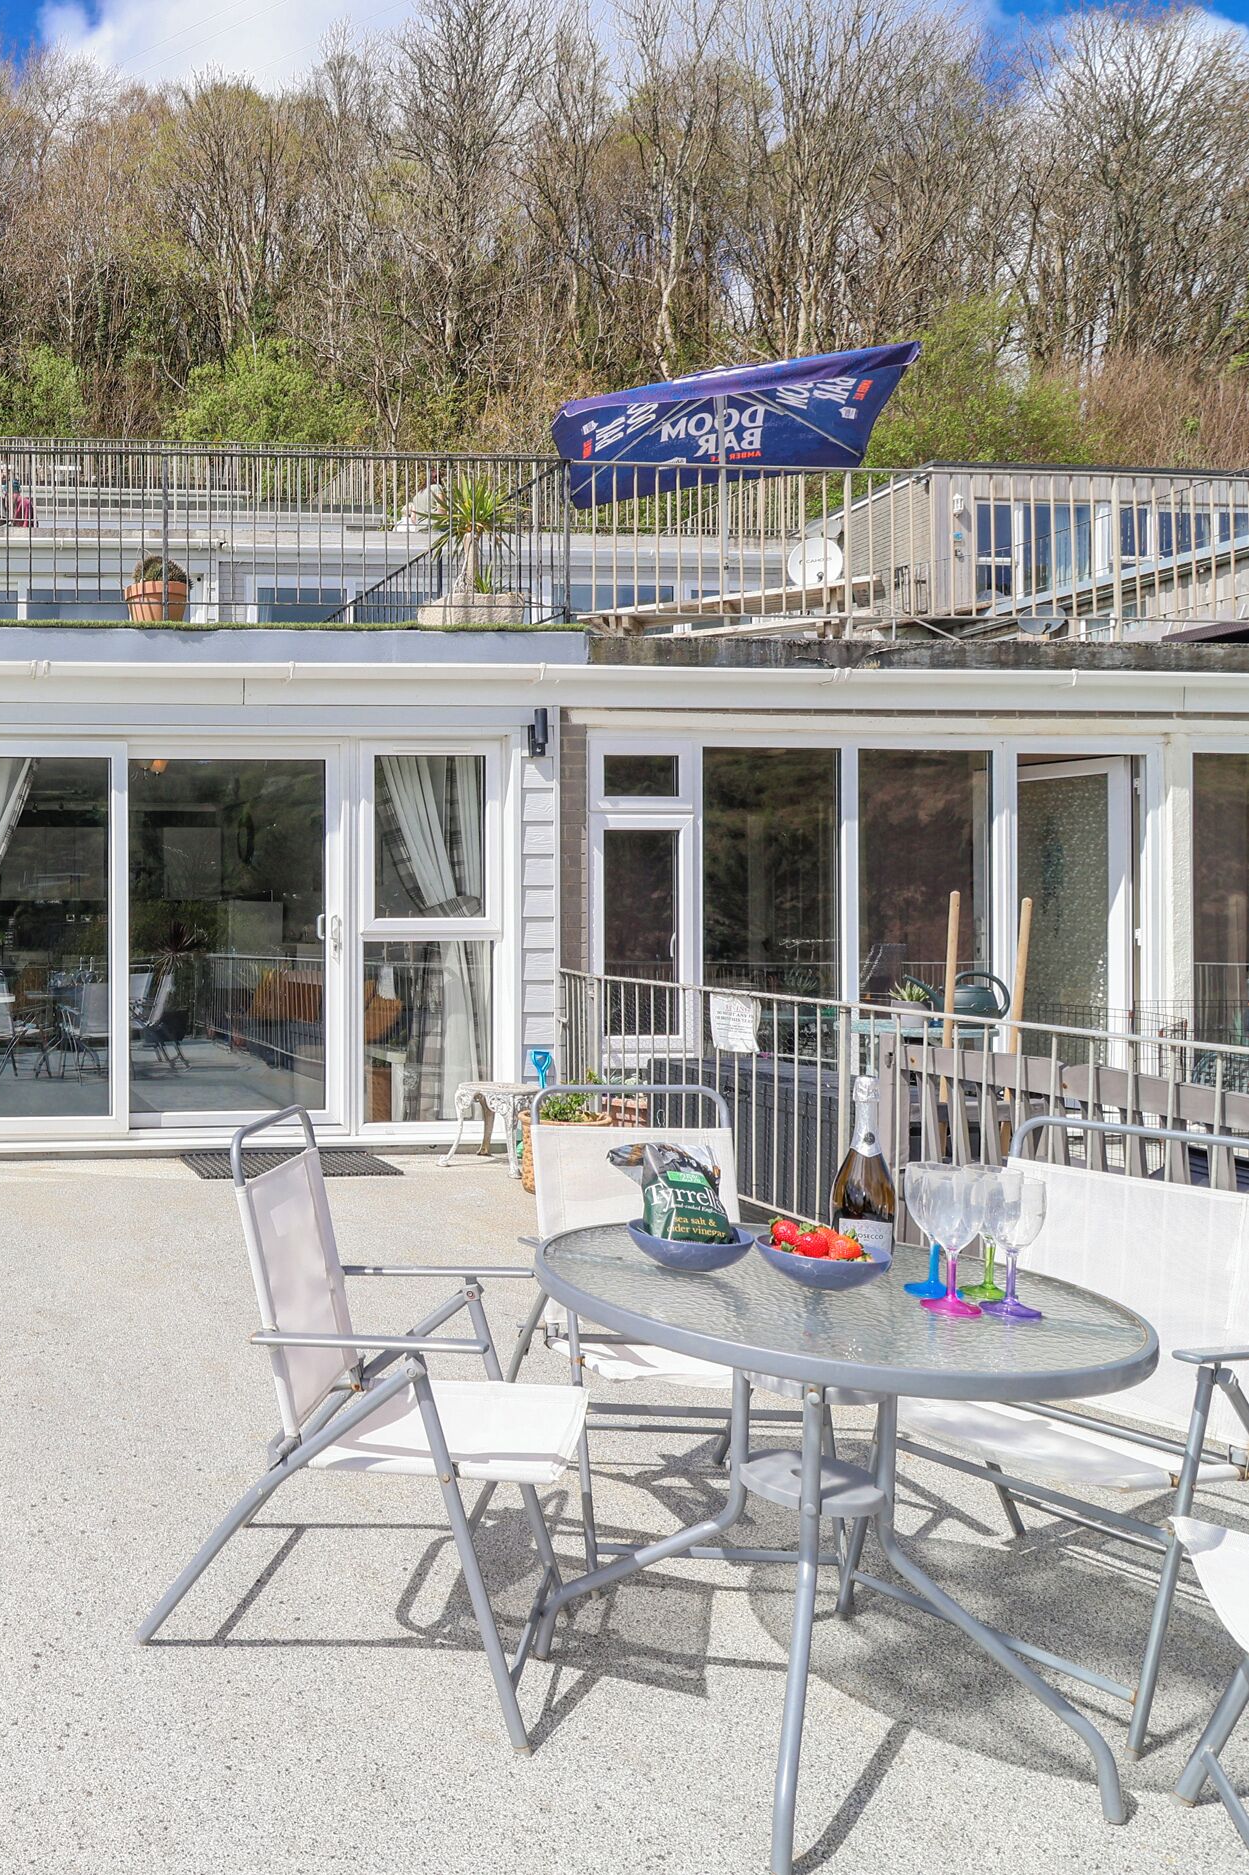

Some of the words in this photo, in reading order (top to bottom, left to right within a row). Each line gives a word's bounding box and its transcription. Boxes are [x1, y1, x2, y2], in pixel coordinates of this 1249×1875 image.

[691, 1217, 707, 1226] salt
[708, 1219, 717, 1227] &
[692, 1225, 726, 1238] vinegar
